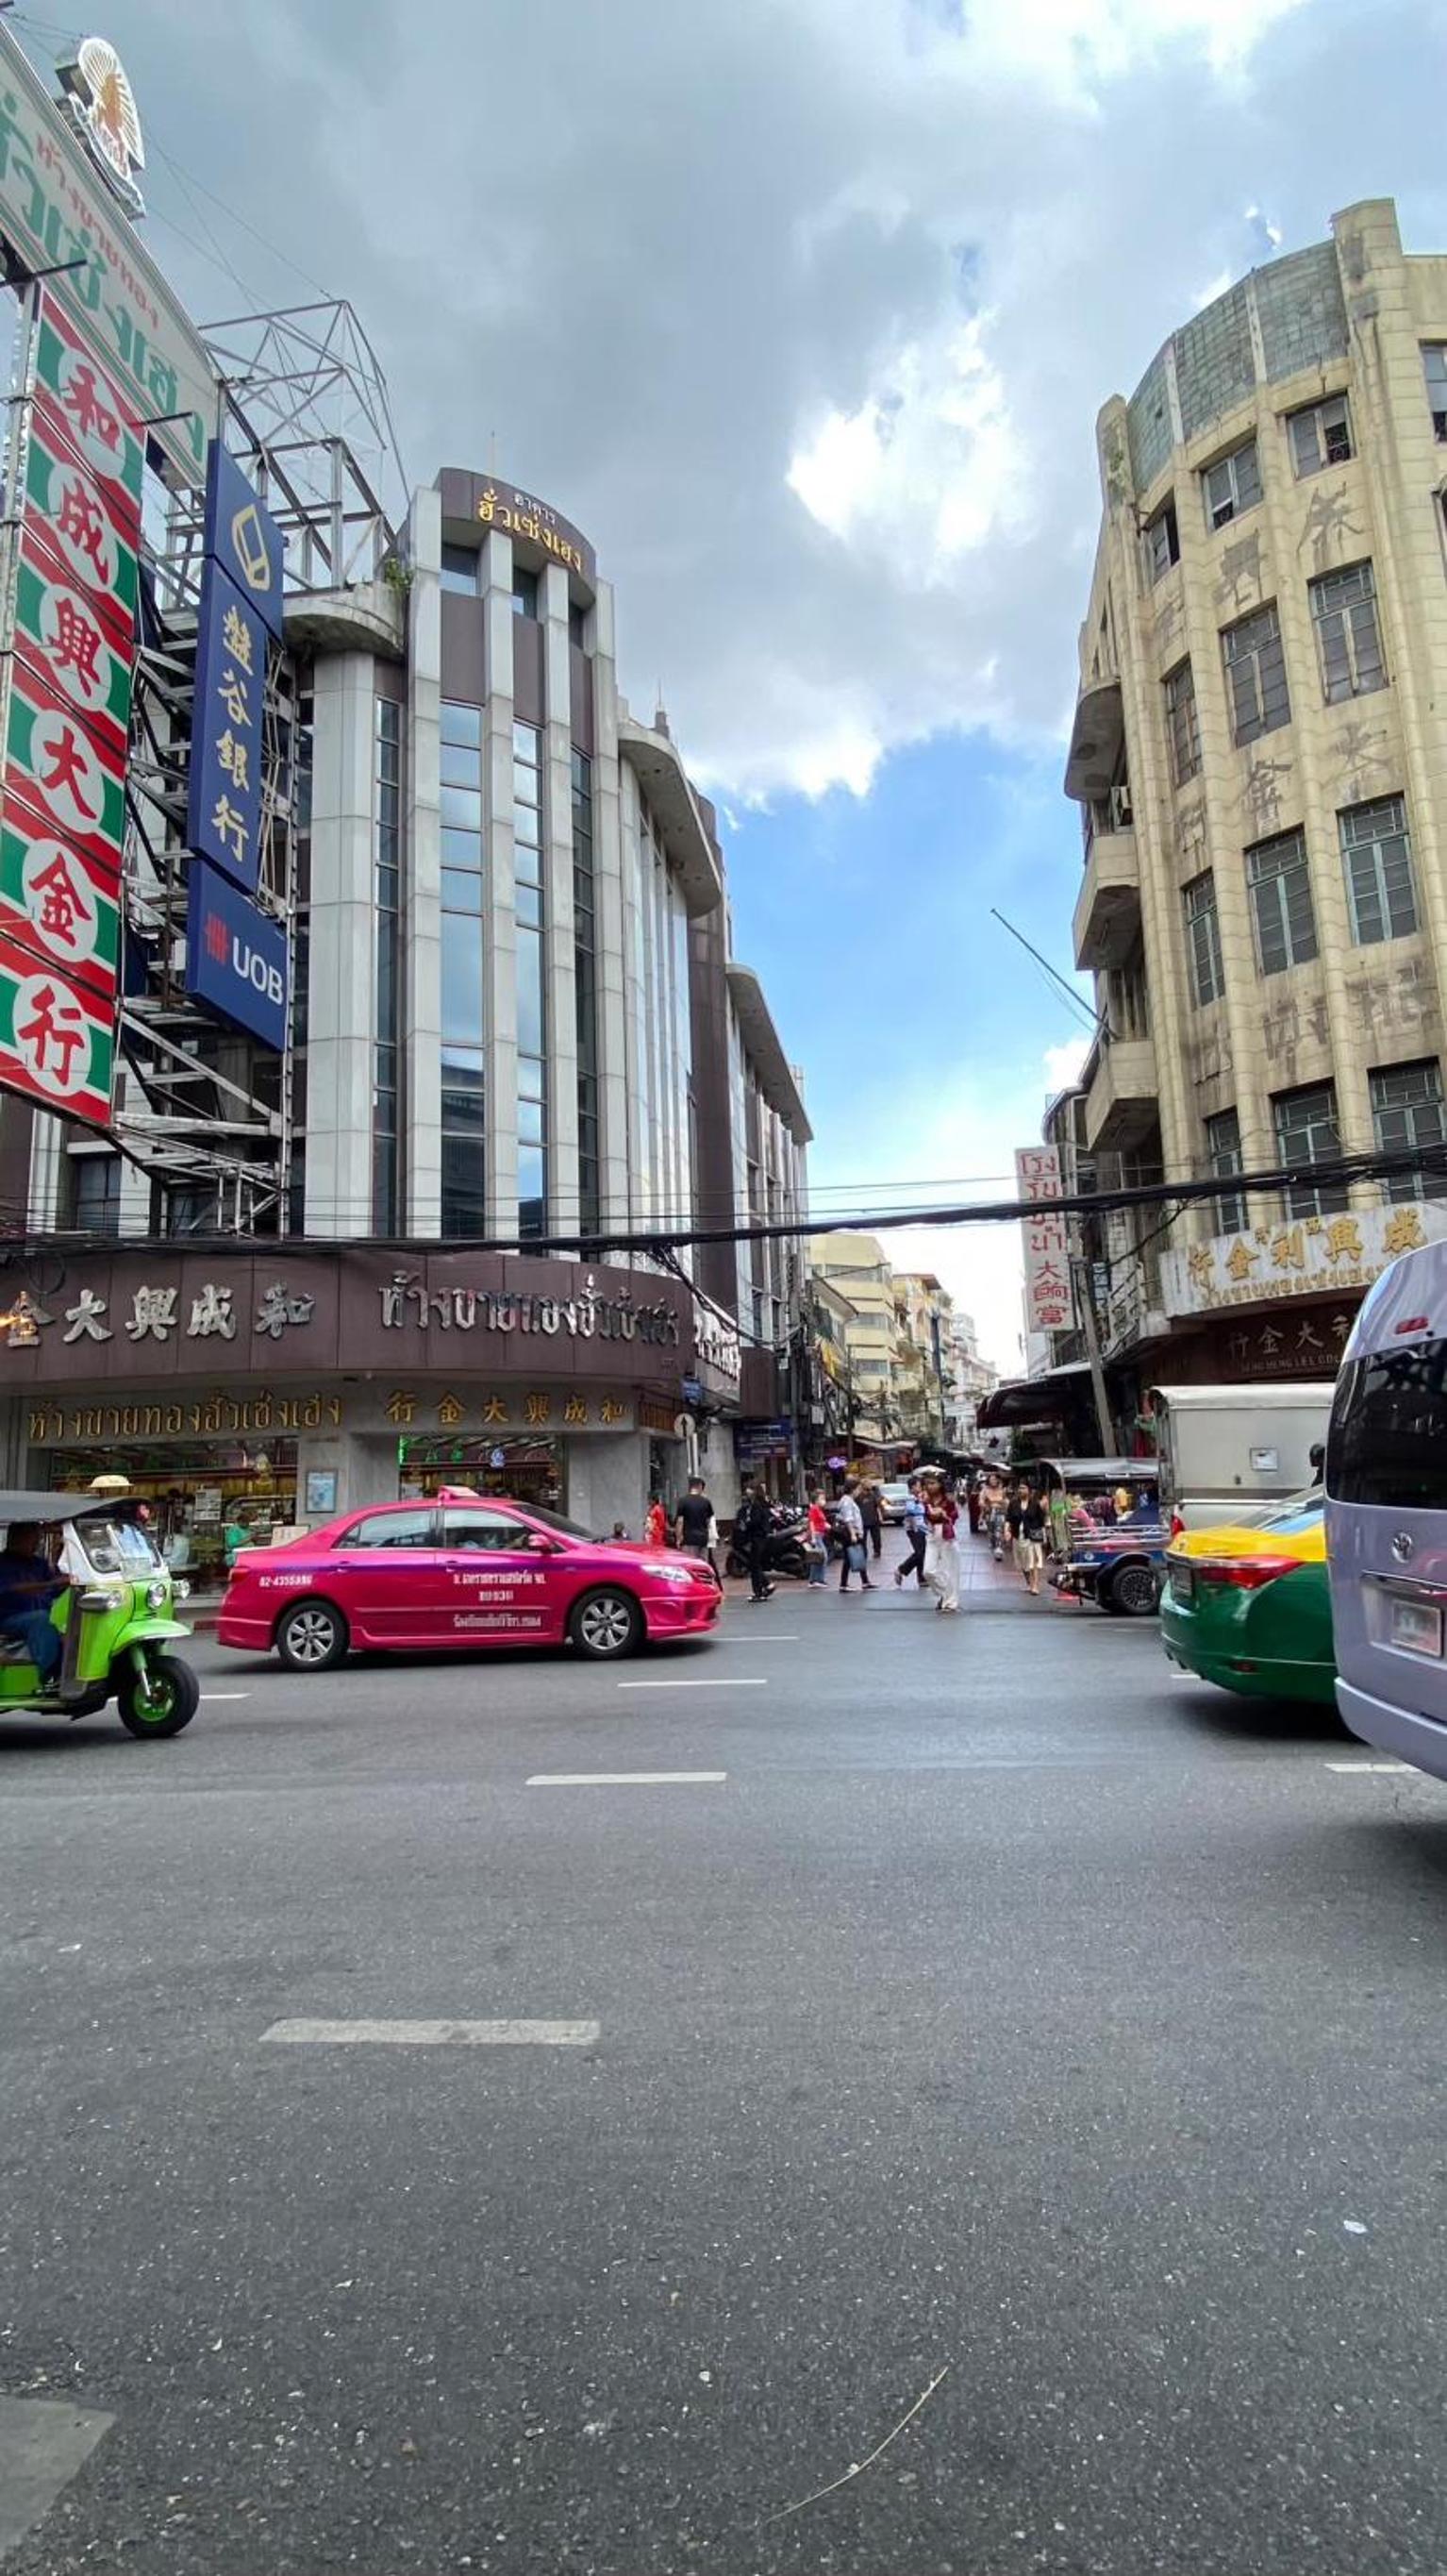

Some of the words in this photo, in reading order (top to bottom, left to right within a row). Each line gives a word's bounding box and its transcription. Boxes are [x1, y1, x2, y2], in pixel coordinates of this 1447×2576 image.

[514, 493, 556, 527] อาคาร
[17, 362, 121, 1087] 和成興大金行
[232, 935, 284, 1006] UOB
